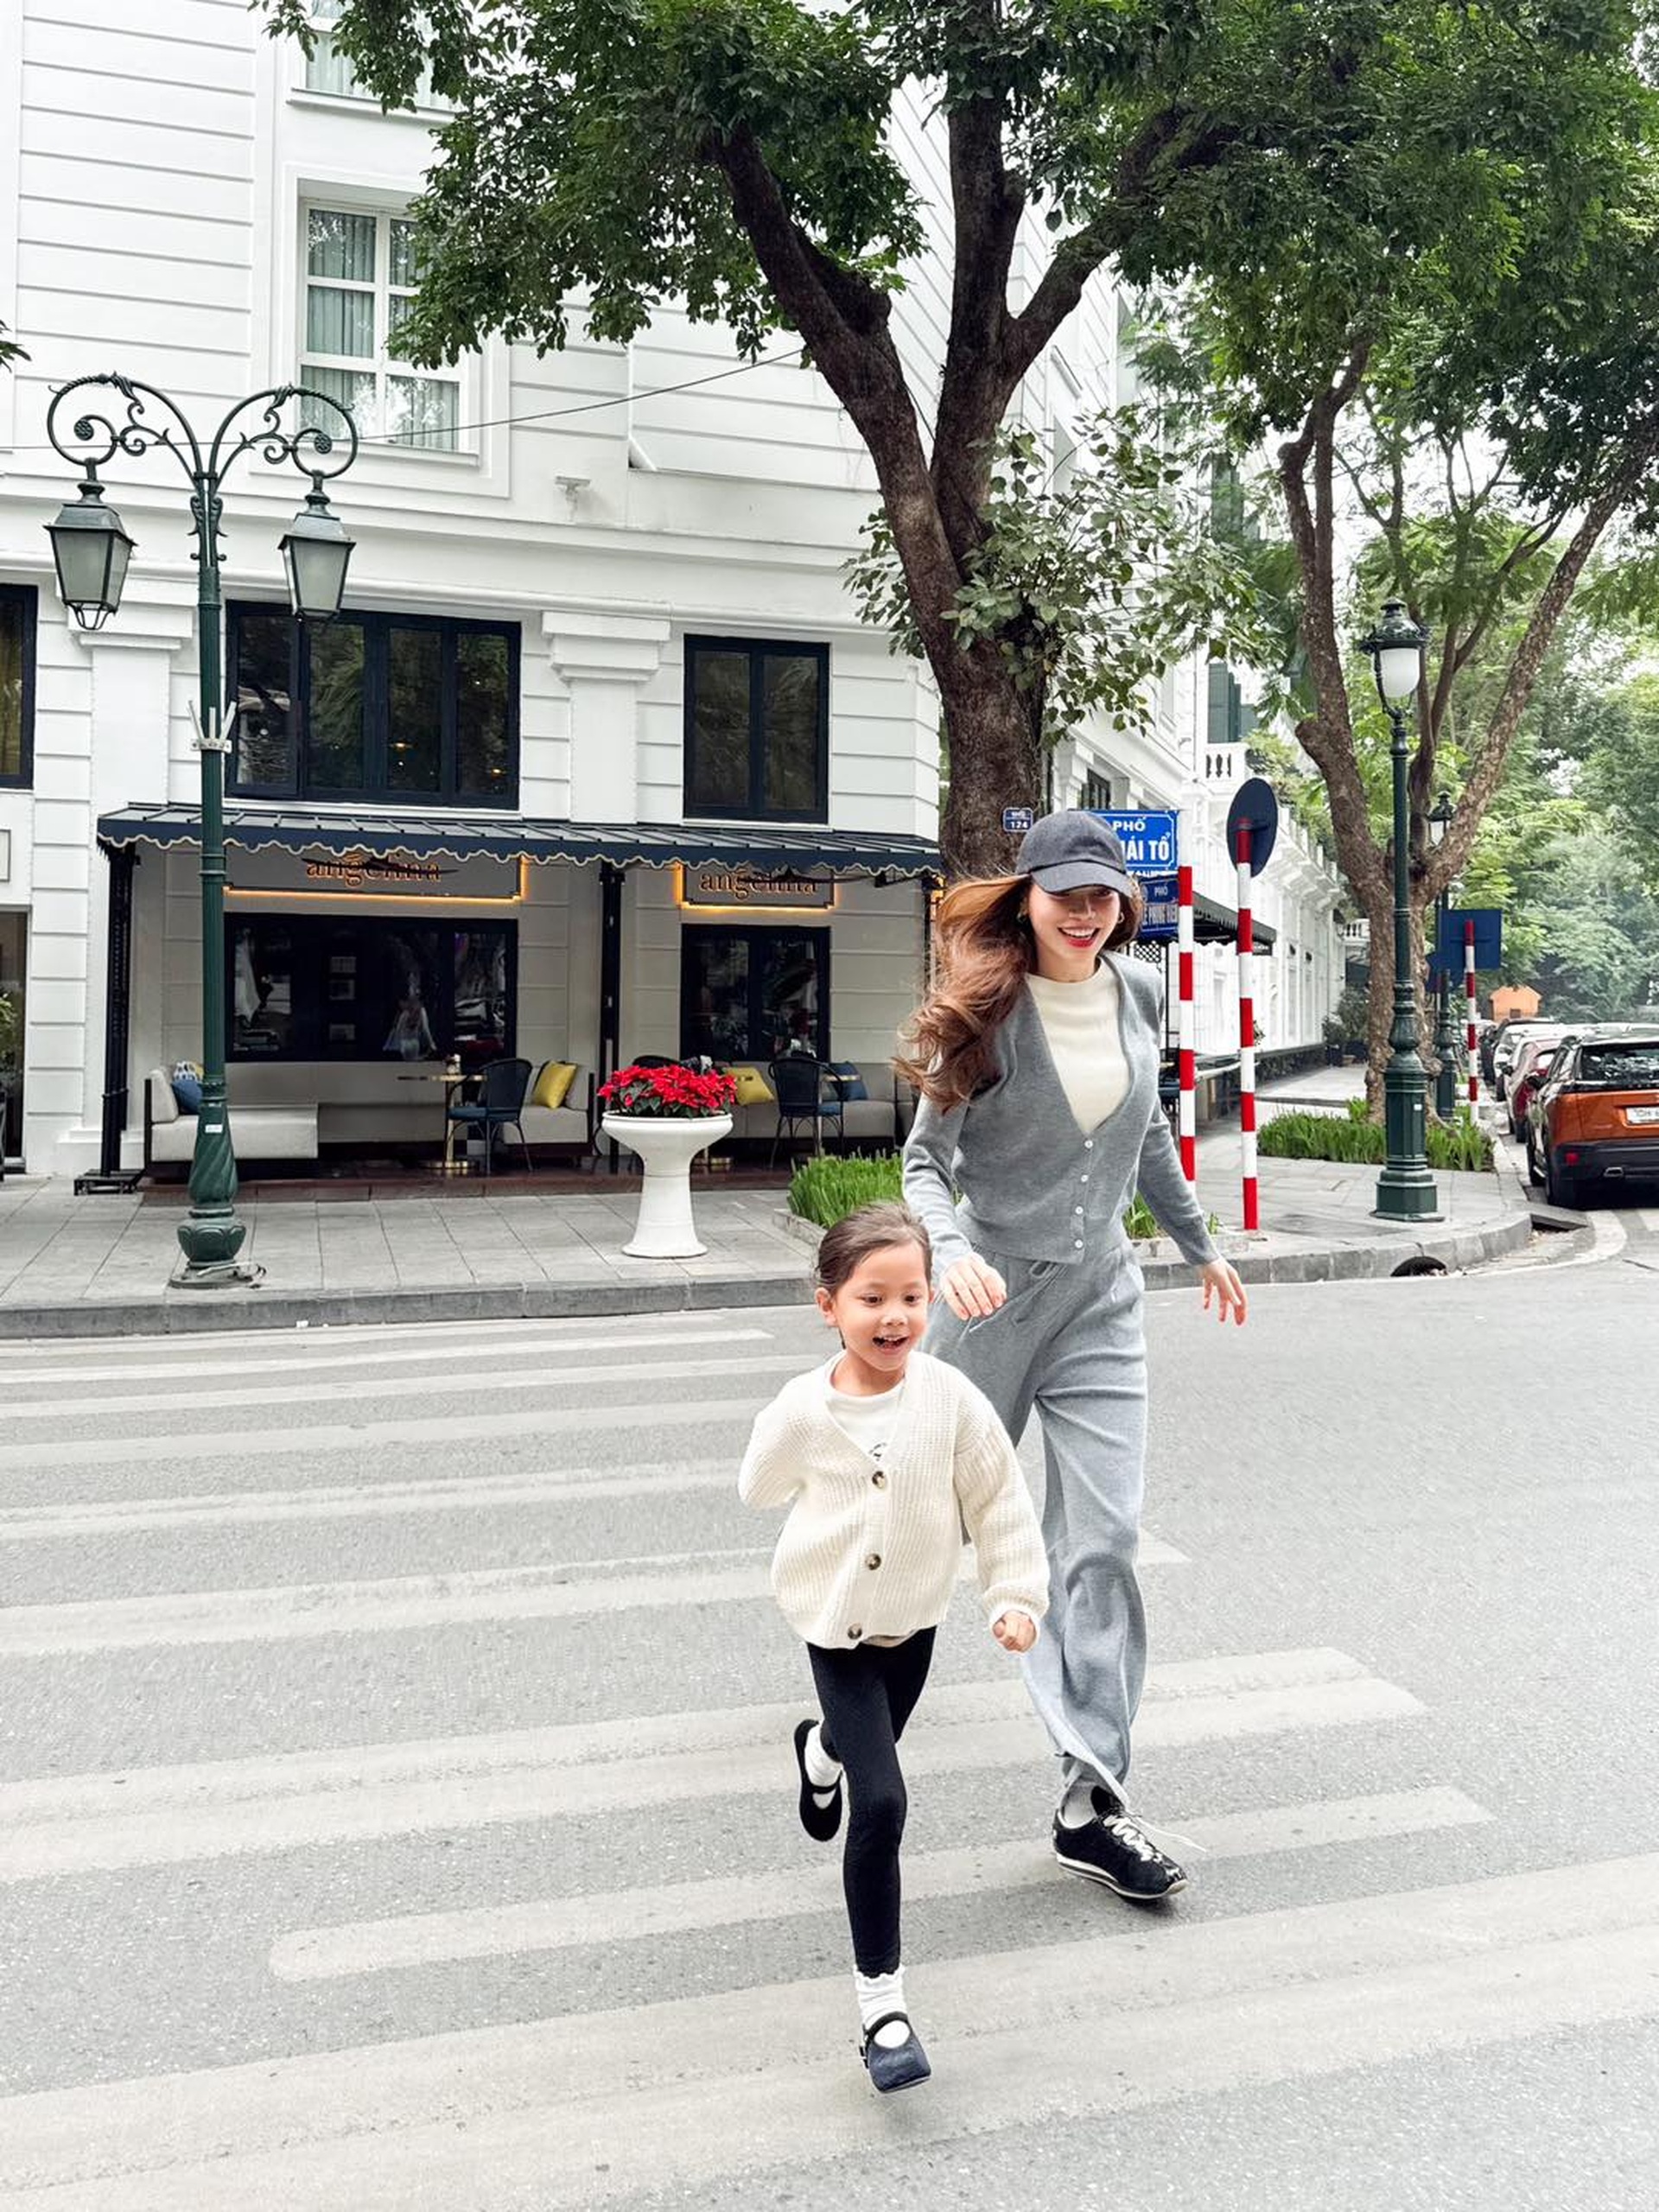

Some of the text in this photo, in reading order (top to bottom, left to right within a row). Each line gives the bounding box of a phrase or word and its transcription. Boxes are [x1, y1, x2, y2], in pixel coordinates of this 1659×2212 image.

[1112, 817, 1147, 832] PHỐ
[1121, 831, 1171, 861] ÁI TỔ
